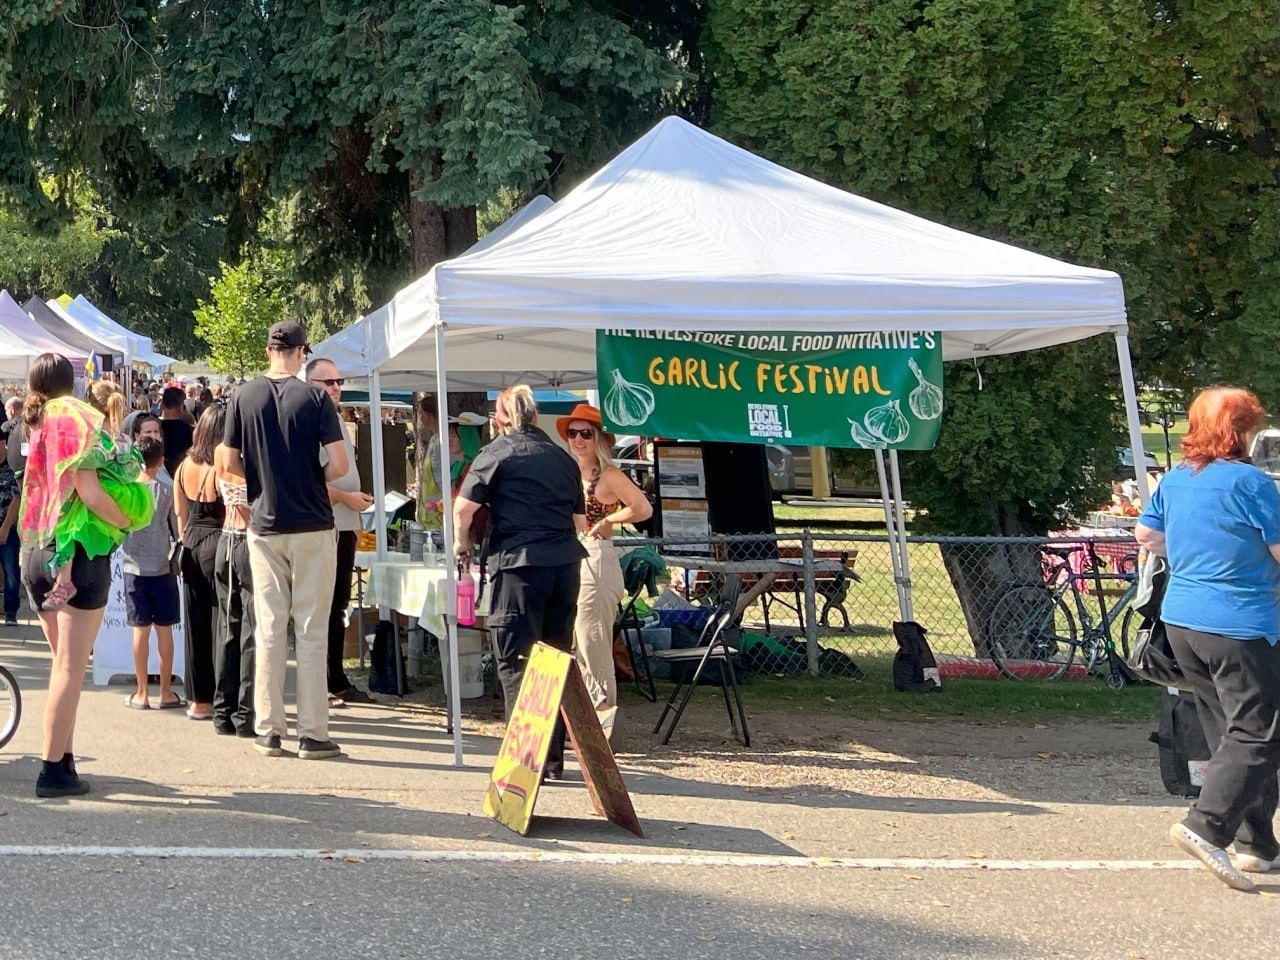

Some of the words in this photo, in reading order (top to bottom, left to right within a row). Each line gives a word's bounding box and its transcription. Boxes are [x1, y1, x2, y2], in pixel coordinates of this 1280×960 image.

[635, 329, 735, 347] REVELSTOKE
[738, 335, 788, 352] LOCAL
[792, 335, 834, 352] FOOD
[836, 331, 935, 350] INITIATIVE'S
[748, 409, 782, 425] LOCAL
